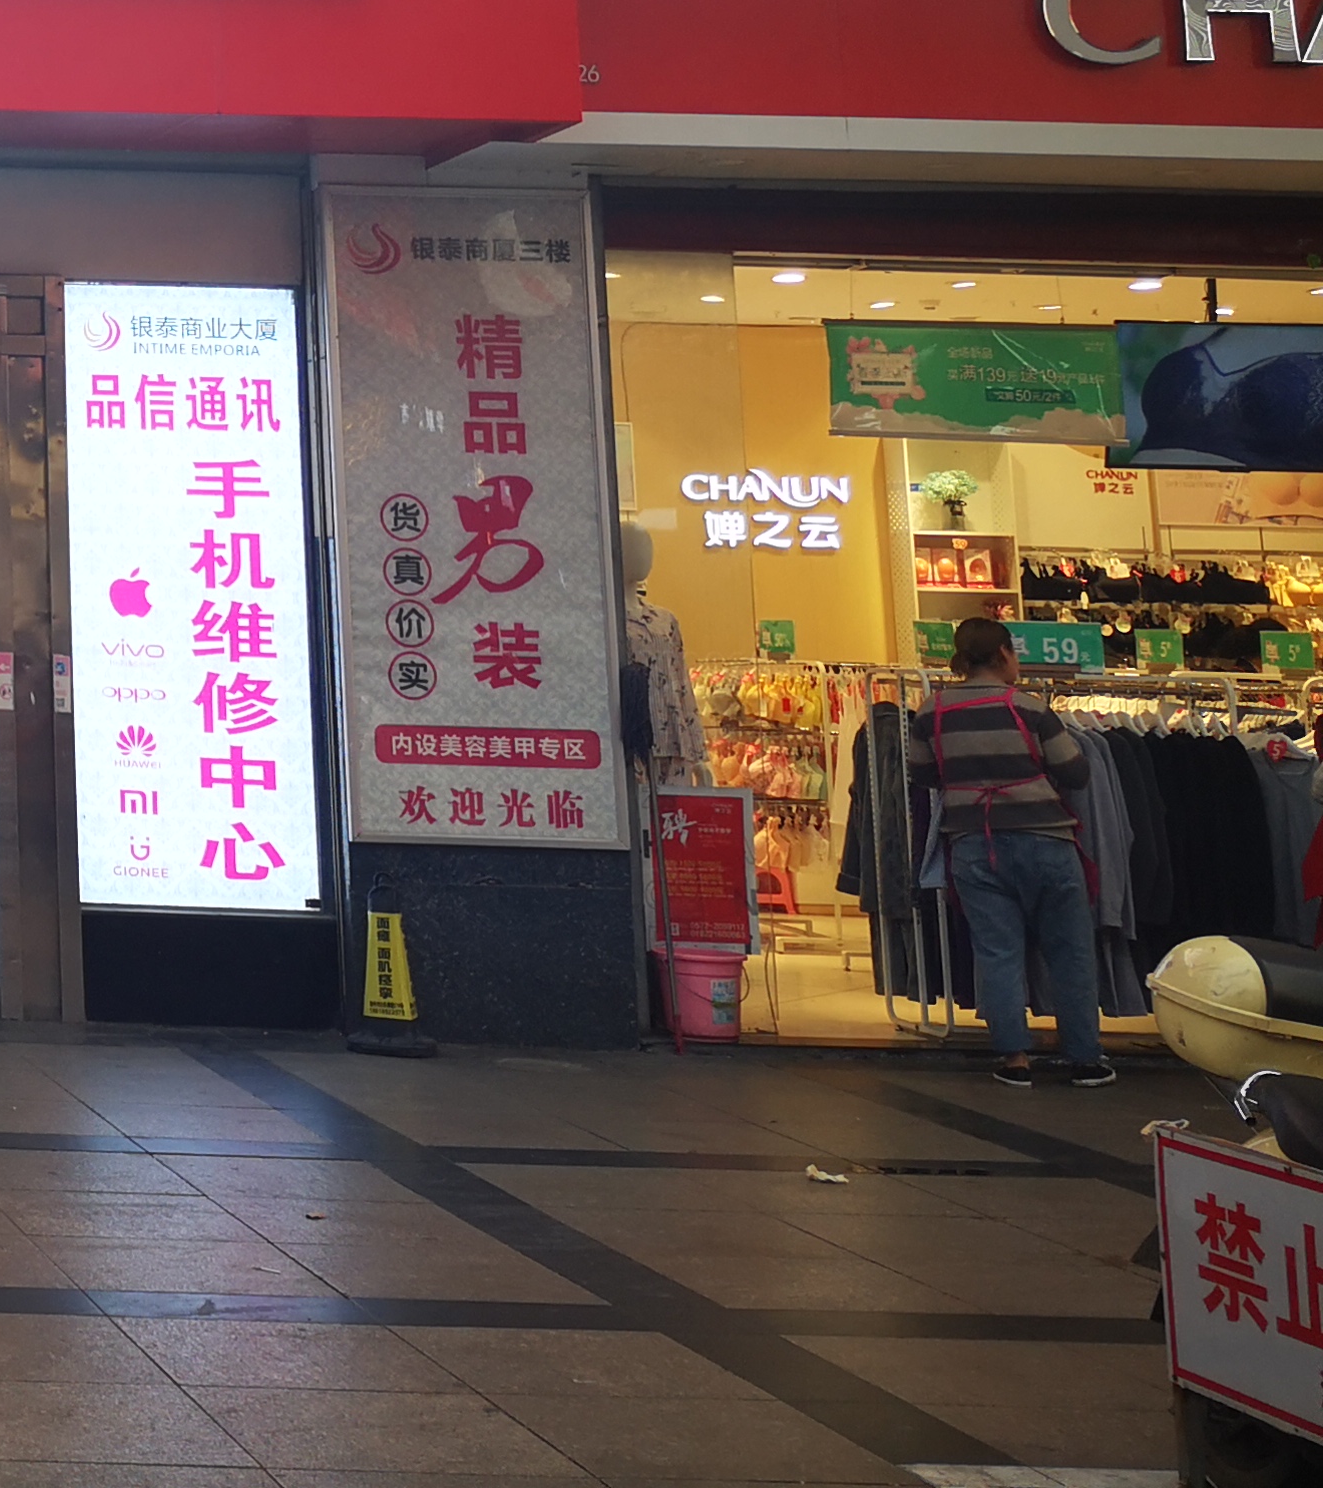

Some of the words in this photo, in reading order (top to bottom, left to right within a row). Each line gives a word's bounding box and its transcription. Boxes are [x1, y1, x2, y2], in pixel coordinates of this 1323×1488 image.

[411, 235, 571, 265] 银泰商厦三楼
[130, 314, 278, 343] 银泰商业大厦
[133, 343, 186, 355] INTIME
[191, 344, 261, 357] EMPORIA
[86, 373, 281, 433] 品信通讯
[681, 469, 850, 508] CHANUN
[1085, 468, 1138, 483] CHANUN
[430, 313, 545, 691] 精品男装
[704, 511, 841, 550] 婵之云
[388, 501, 430, 694] 货真价实
[101, 639, 165, 659] vivo
[186, 458, 285, 882] 手机维修中心
[390, 730, 586, 761] 内设美容美甲专区
[114, 759, 161, 769] HUAWEI
[397, 787, 584, 831] 欢迎光临
[661, 808, 697, 847] 聘
[113, 865, 169, 878] GIONEE
